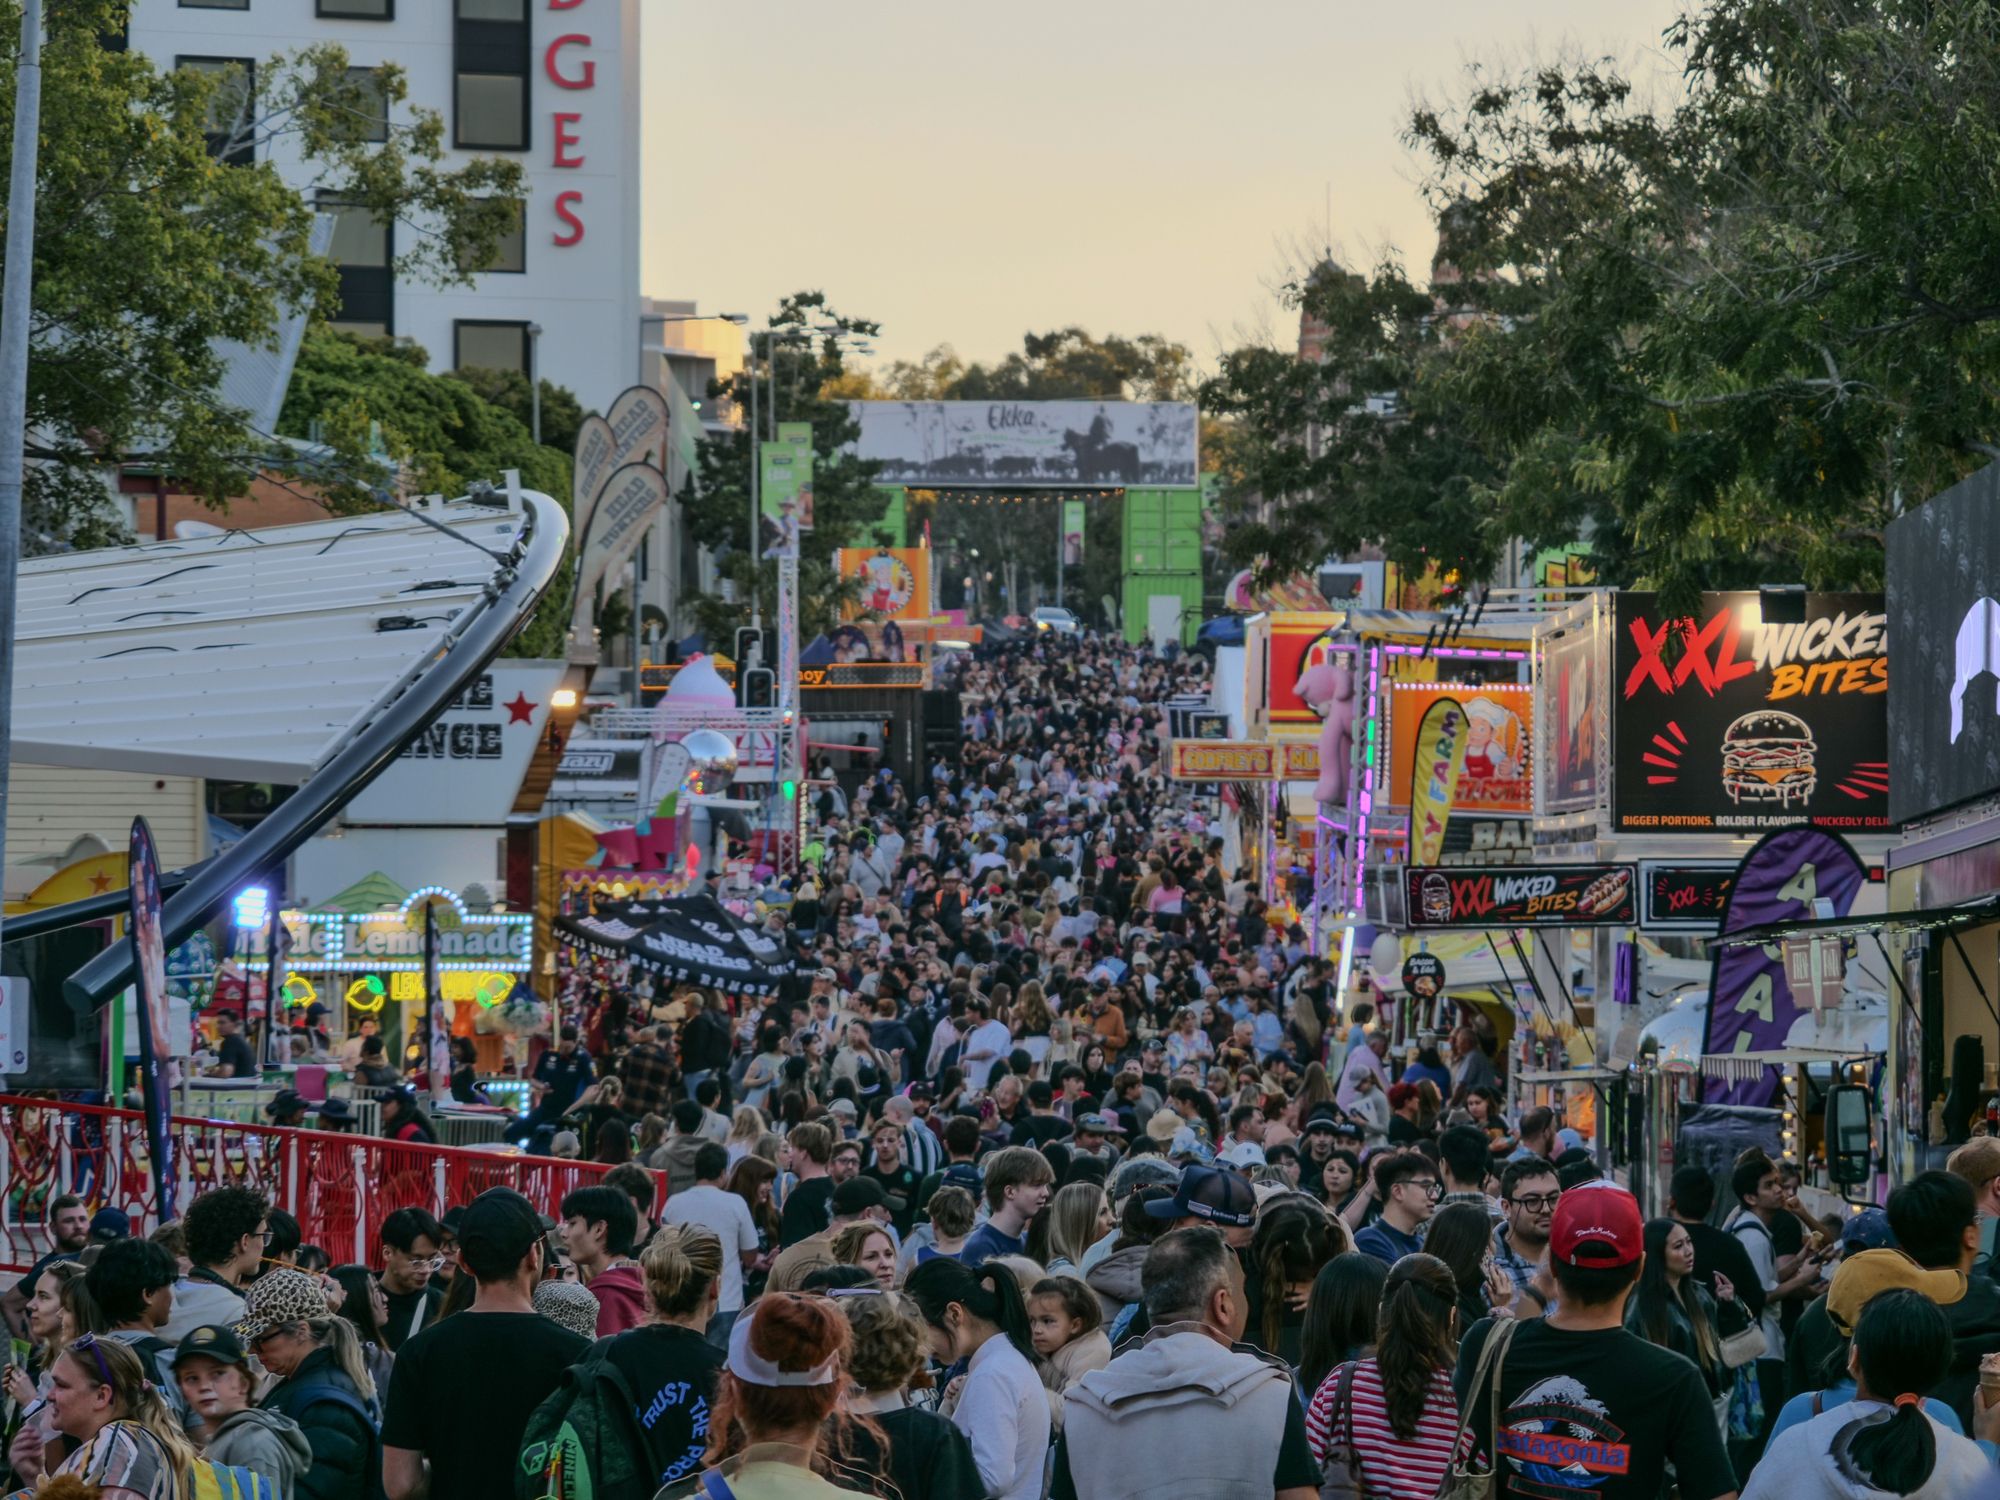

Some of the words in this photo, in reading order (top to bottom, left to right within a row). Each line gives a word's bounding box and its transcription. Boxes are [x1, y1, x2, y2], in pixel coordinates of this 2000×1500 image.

[544, 0, 596, 247] GES
[612, 399, 649, 441] HEAD
[988, 404, 1034, 430] Ekka
[601, 487, 659, 549] HUNTERS
[605, 476, 647, 519] HEAD
[1625, 607, 1756, 699] XXL
[1752, 610, 1887, 671] WICKE
[1765, 656, 1887, 700] BITES
[400, 723, 502, 759] NGE
[1429, 711, 1460, 804] FARM
[1622, 815, 1659, 826] BIGGER
[1661, 815, 1714, 826] PORTIONS.
[1716, 815, 1755, 826] BOLDER
[1813, 816, 1863, 826] WICKEDLY
[1866, 816, 1893, 827] DELI
[1451, 875, 1496, 918] XXL
[1494, 876, 1556, 905] WICKED
[1527, 890, 1578, 914] BITES
[1668, 885, 1699, 912] XXL
[344, 922, 530, 955] Lemnade
[659, 932, 724, 957] HEAD
[642, 1381, 691, 1430] TRUST
[690, 1396, 710, 1439] THE
